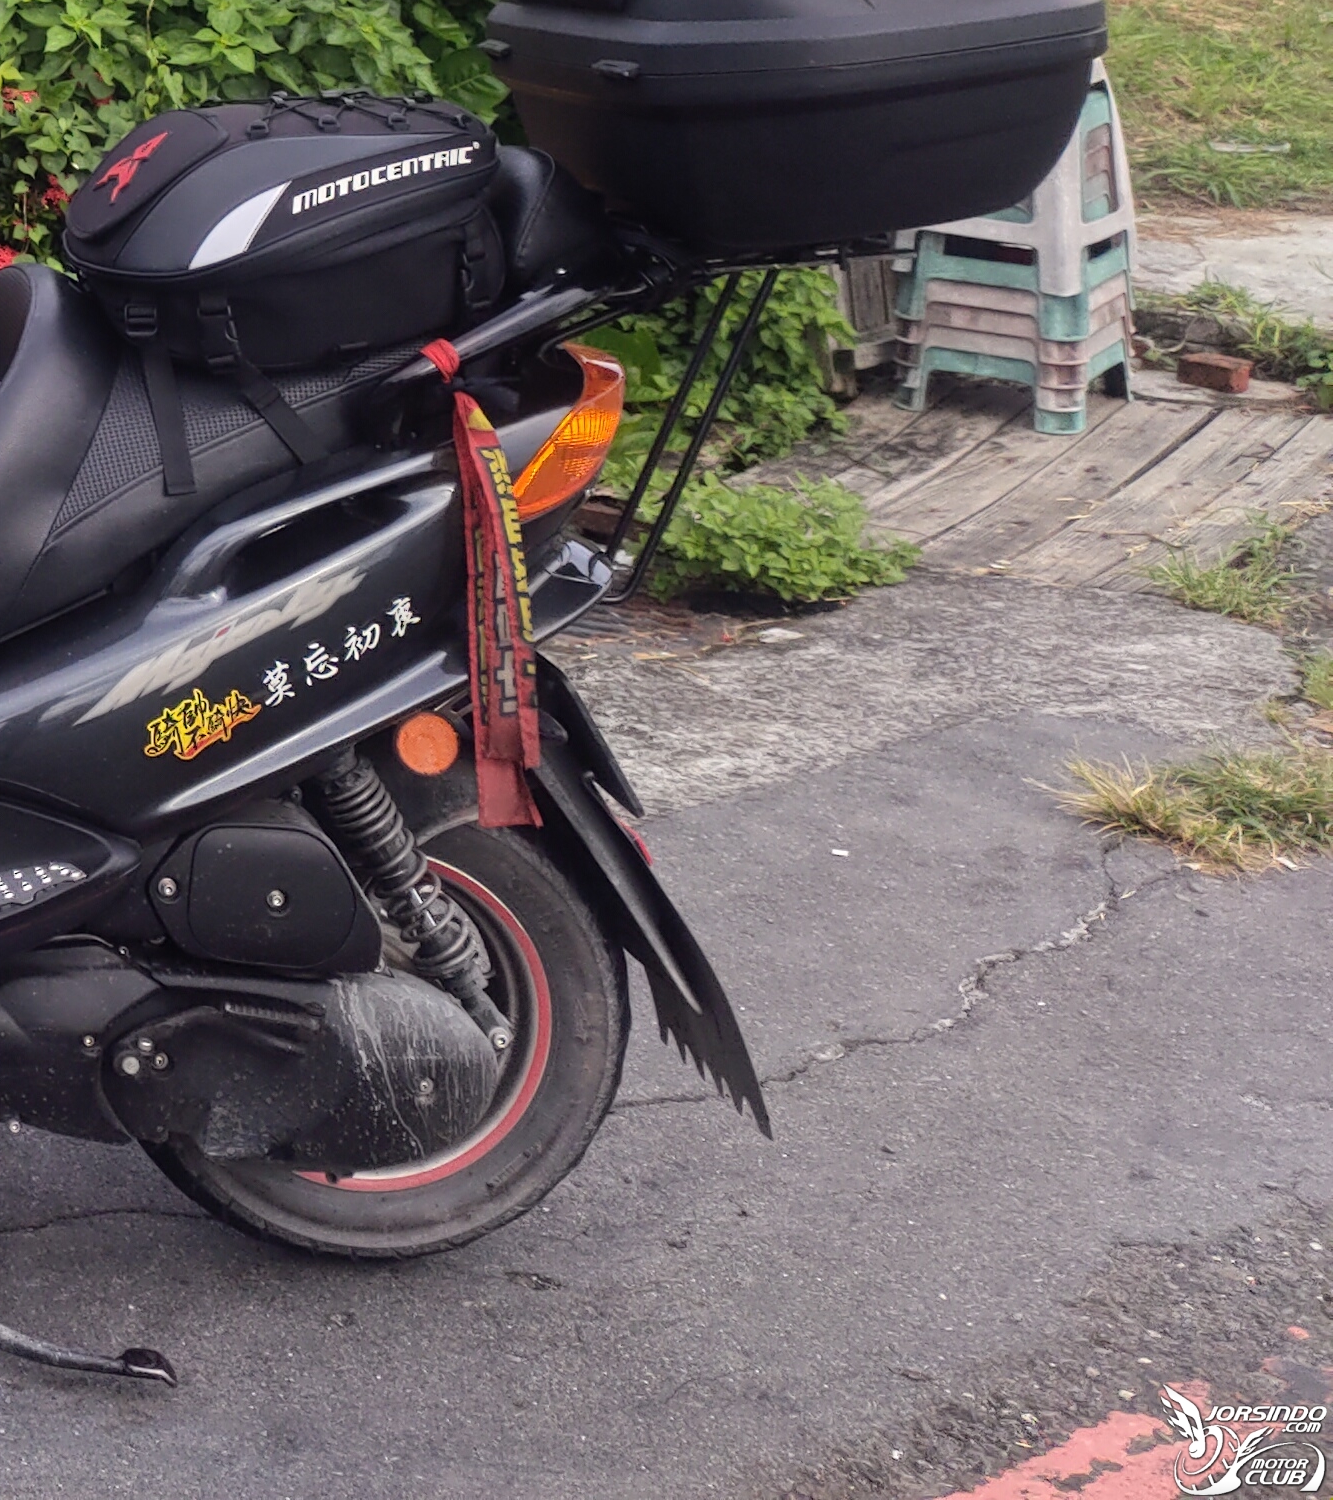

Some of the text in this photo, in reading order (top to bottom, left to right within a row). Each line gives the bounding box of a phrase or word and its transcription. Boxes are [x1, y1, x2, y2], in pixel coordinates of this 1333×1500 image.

[292, 147, 473, 215] MOTOCENTRIC
[263, 596, 422, 708] 莫忘初衷
